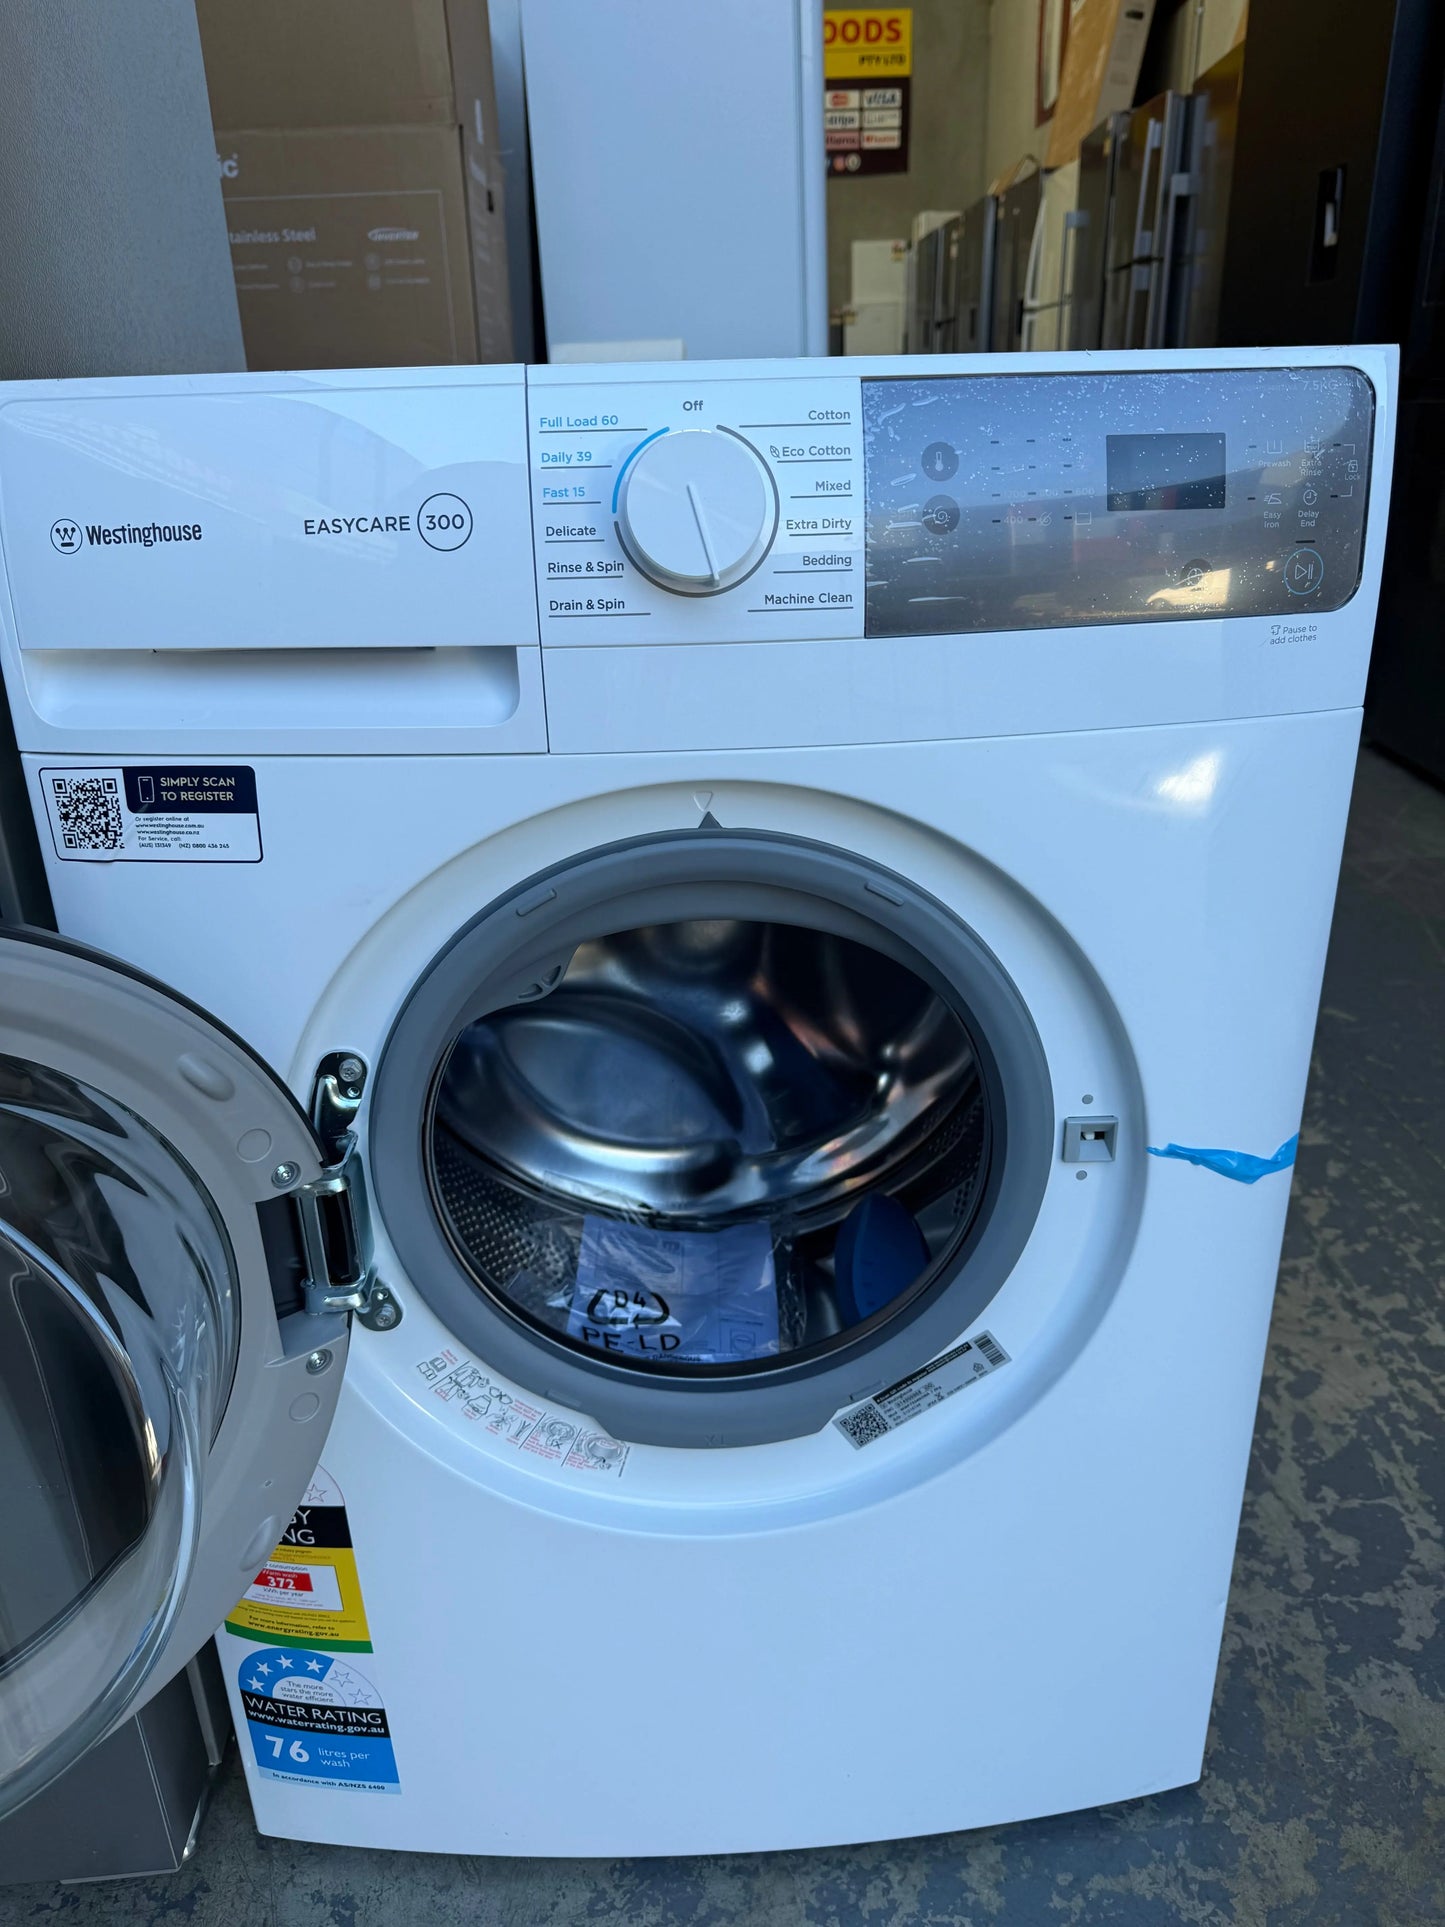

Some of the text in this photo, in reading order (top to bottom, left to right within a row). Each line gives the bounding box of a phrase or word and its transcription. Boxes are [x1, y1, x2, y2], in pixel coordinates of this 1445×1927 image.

[282, 228, 316, 242] Steel
[683, 401, 703, 411] Off
[540, 415, 618, 427] Full Load 60
[808, 410, 850, 421] Cotton
[782, 446, 851, 457] Eco Cotton
[541, 451, 592, 464] Daily 39
[815, 481, 851, 492] Mixed
[1076, 487, 1095, 496] 600
[543, 487, 585, 498] Fast 15
[1264, 512, 1281, 520] Easy
[1298, 510, 1319, 518] Delay
[303, 514, 465, 535] EASYCARE 300
[786, 518, 852, 531] Extra Dirty
[1004, 515, 1023, 525] 400
[85, 523, 202, 548] Westinghouse
[546, 526, 596, 537] Delicate
[802, 555, 852, 568] Bedding
[548, 561, 624, 574] Rinse & Spin
[764, 593, 853, 605] Machine Clean
[549, 599, 625, 611] Drain & Spin
[1283, 626, 1306, 634] Pause
[1270, 634, 1317, 645] add clothes
[160, 777, 235, 787] SIMPLY SCAN
[161, 791, 234, 801] TO REGISTER
[267, 1576, 296, 1589] 372
[248, 1621, 339, 1637] www.energyrating.gov.au
[305, 1695, 334, 1703] efficient
[245, 1695, 382, 1724] WATER RATING
[248, 1710, 385, 1733] www.waterrating.gov.au
[265, 1734, 370, 1763] 76 litres per
[322, 1759, 351, 1768] wash
[281, 1775, 319, 1784] accordance
